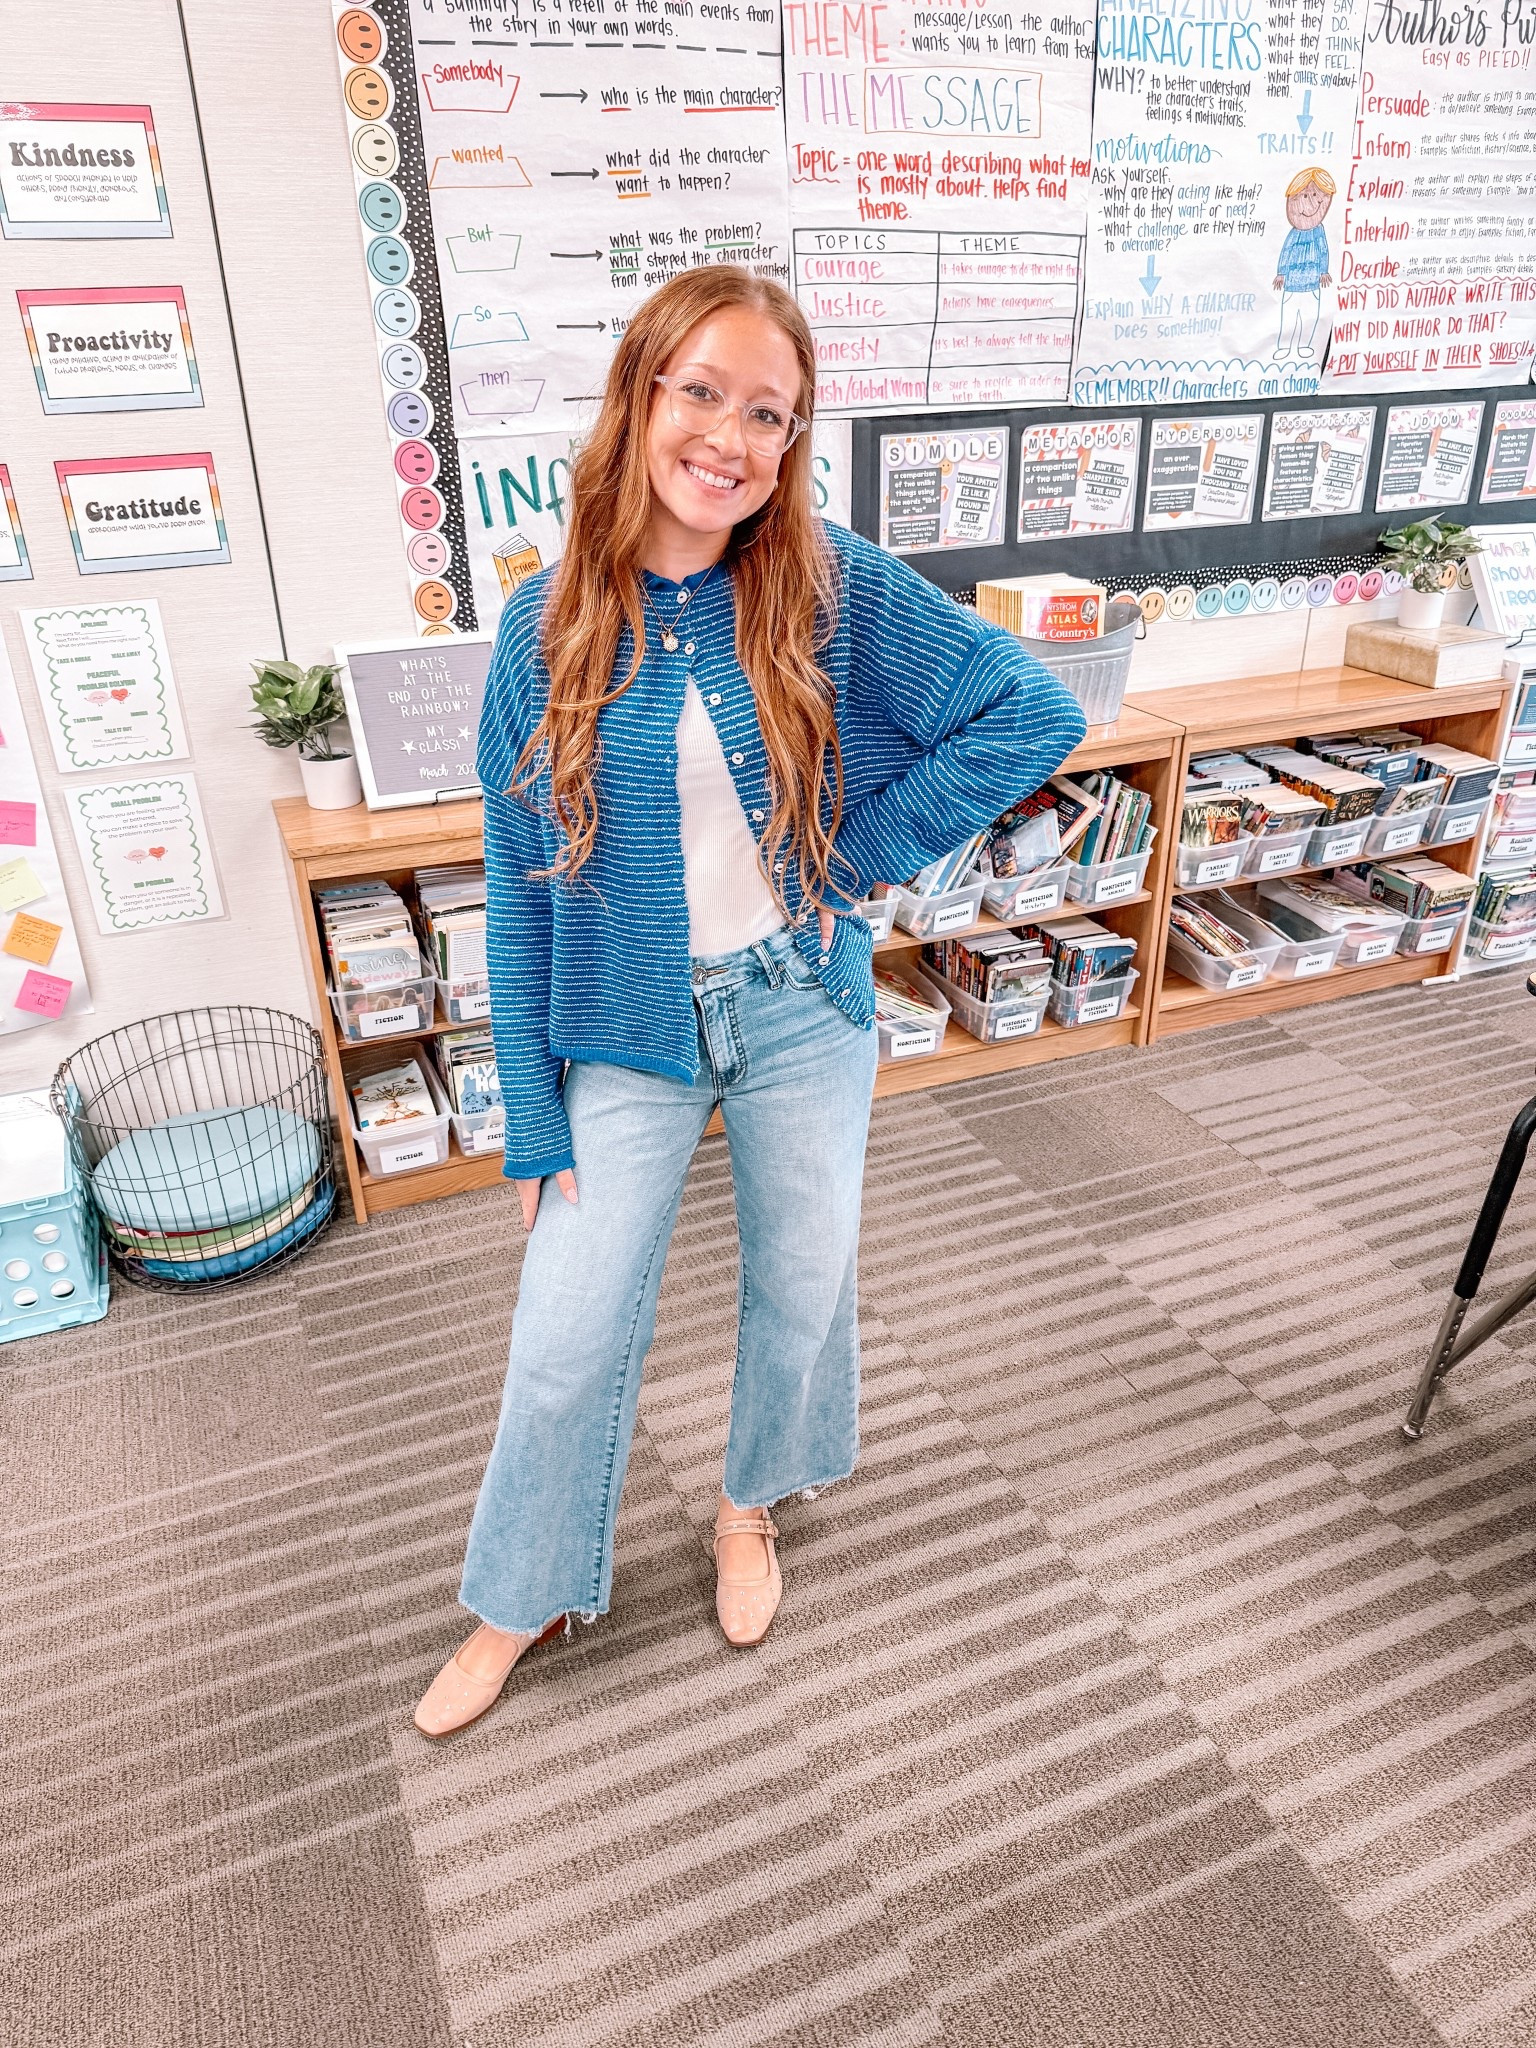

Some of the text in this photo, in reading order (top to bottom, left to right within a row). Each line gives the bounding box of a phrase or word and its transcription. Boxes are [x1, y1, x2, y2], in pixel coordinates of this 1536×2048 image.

[469, 17, 678, 38] the story in your own words.
[912, 33, 1096, 60] wants you to learn from text
[1099, 15, 1261, 71] CHARACTERS
[1268, 34, 1361, 52] what they THINK
[434, 60, 503, 87] Somebody
[1151, 75, 1250, 97] to better understand
[601, 86, 782, 107] who is the main character?
[1457, 90, 1481, 102] author
[8, 142, 135, 167] Kindness
[606, 147, 769, 168] what did the character
[1096, 133, 1222, 164] motivations
[794, 143, 838, 177] Topic
[857, 152, 887, 172] one
[895, 152, 931, 175] word
[942, 150, 1021, 179] describing
[1029, 155, 1066, 175] what
[616, 172, 731, 194] want to happen?
[858, 175, 1067, 200] is mostly about. Helps find
[1131, 184, 1262, 204] are they acting like that?
[1134, 203, 1255, 221] do they want or need?
[468, 225, 493, 242] But
[609, 222, 761, 249] what was the problem?
[1138, 219, 1265, 240] challenge are they trying
[815, 234, 1020, 252] TOPICS THEME
[1105, 239, 1171, 253] to overcome?
[609, 245, 778, 269] what stopped the character
[809, 292, 885, 319] Justice
[943, 298, 971, 308] Actions
[977, 297, 995, 307] have
[1337, 290, 1367, 311] WHY
[1376, 288, 1398, 309] DID
[1406, 286, 1455, 308] AUTHOR
[1465, 284, 1504, 304] WRITE
[475, 306, 491, 322] So
[1086, 298, 1134, 321] Explain
[1141, 296, 1173, 317] WHY
[1196, 293, 1256, 314] CHARACTER
[1334, 311, 1507, 344] WHY DID AUTHOR DO THAT?
[47, 330, 172, 353] Proactivity
[1338, 353, 1357, 372] PUT
[1364, 349, 1419, 371] YOURSELF
[1424, 349, 1438, 368] IN
[1447, 346, 1481, 366] THEIR
[479, 370, 510, 386] Then
[1172, 378, 1248, 400] Characters
[1258, 379, 1279, 396] can
[1275, 417, 1369, 428] PERSONIFICATION
[1413, 416, 1458, 427] IDIOM
[1029, 432, 1130, 449] METAPHOR
[1157, 427, 1254, 440] HYPERBOLE
[890, 441, 997, 460] SIMILE
[1033, 462, 1077, 472] comparison
[1153, 464, 1198, 473] exaggeration
[1050, 473, 1075, 482] unlike
[918, 488, 934, 496] using
[1037, 486, 1062, 495] things
[85, 496, 201, 522] Gratitude
[1046, 614, 1077, 624] ATLAS
[1050, 629, 1095, 639] Country's
[400, 656, 447, 672] WHAT'S
[87, 670, 120, 679] PEACEFUL
[404, 671, 452, 686] AT THE
[77, 682, 108, 691] PROBLEM
[388, 684, 472, 703] END OF THE
[401, 701, 469, 718] RAINBOW?
[426, 725, 445, 738] MY
[419, 763, 476, 780] March 202
[1188, 805, 1239, 825] WARRIORS
[939, 910, 969, 922] NONFICTION
[375, 1015, 404, 1024] FICTION
[395, 1151, 424, 1162] FICTION
